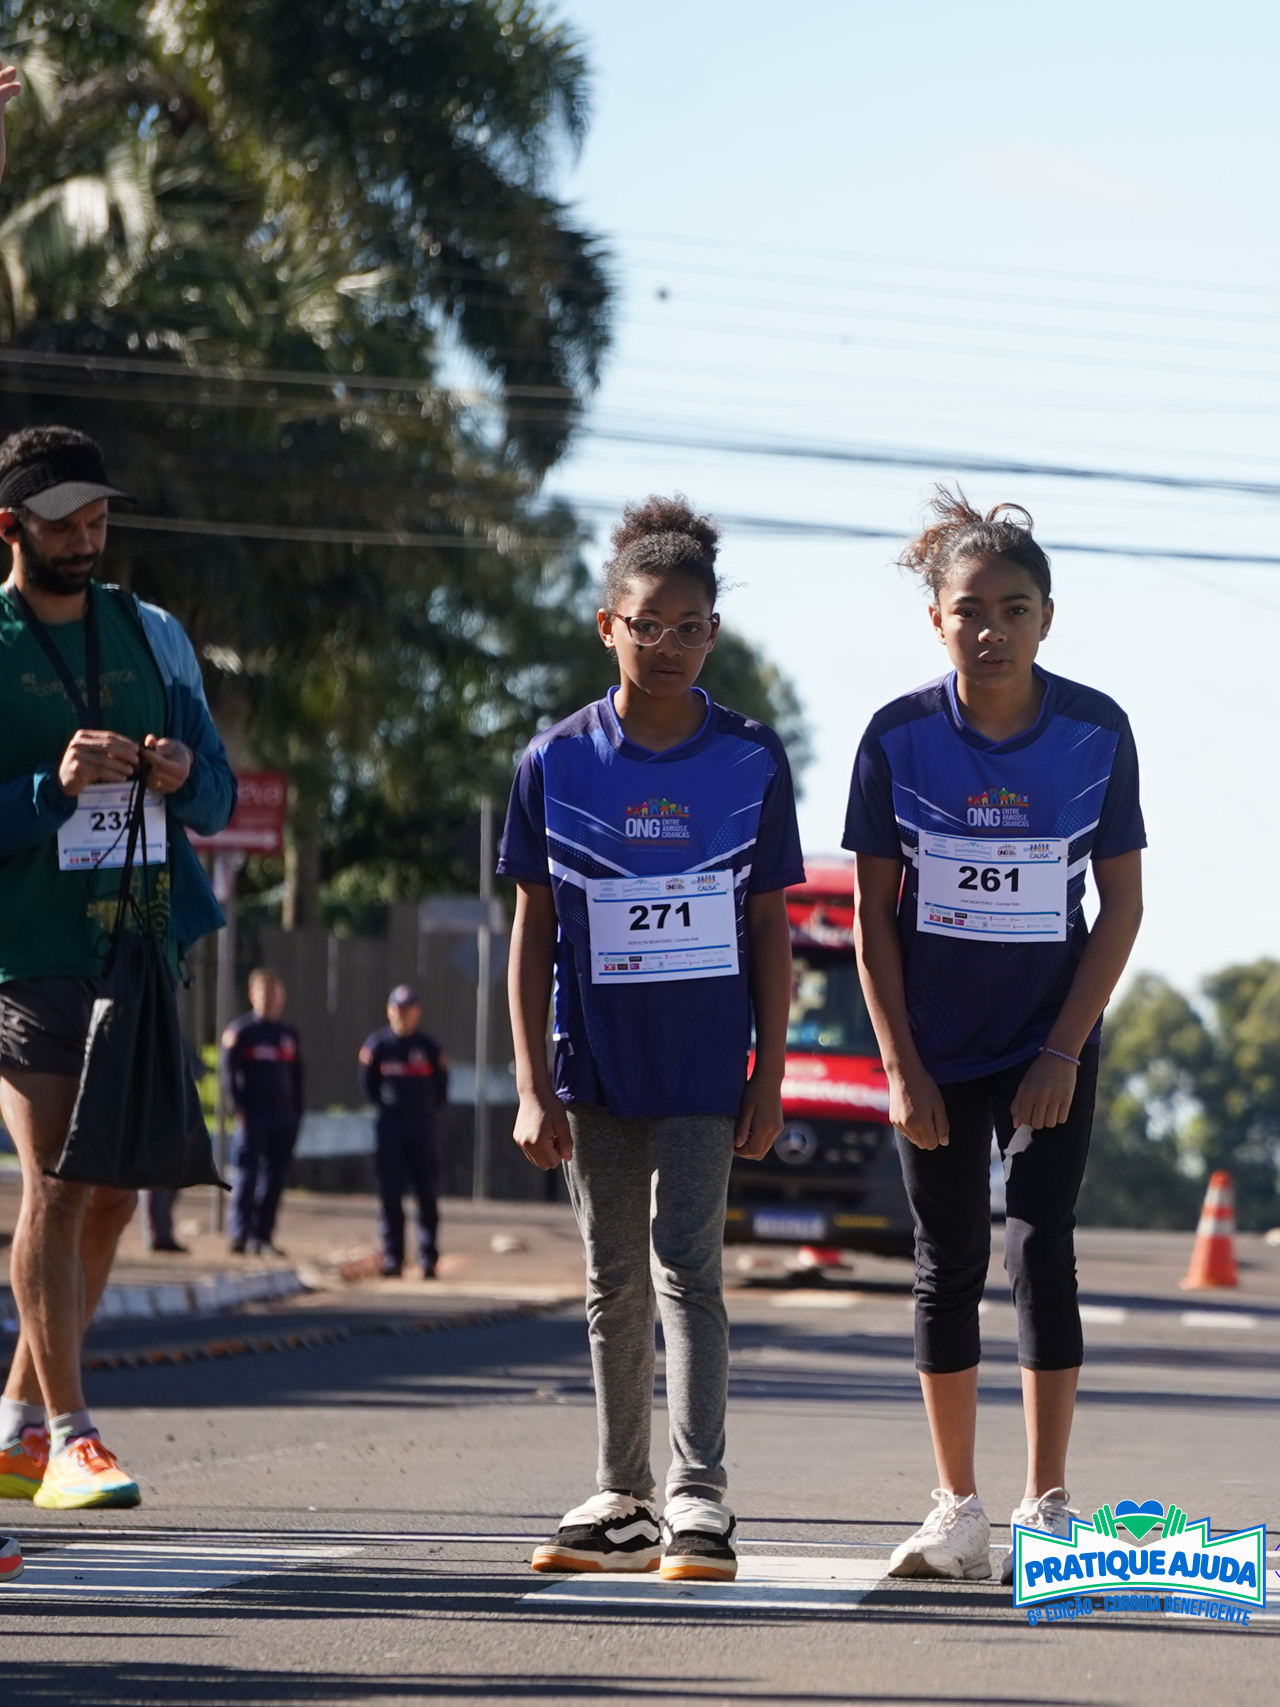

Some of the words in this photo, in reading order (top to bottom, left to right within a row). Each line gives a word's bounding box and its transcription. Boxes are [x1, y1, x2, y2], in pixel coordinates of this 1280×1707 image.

[661, 818, 680, 826] ENTRE
[966, 807, 1001, 827] ONG
[625, 817, 661, 838] ONG
[697, 884, 717, 892] CAUSA
[958, 866, 1019, 892] 261
[629, 902, 691, 931] 271
